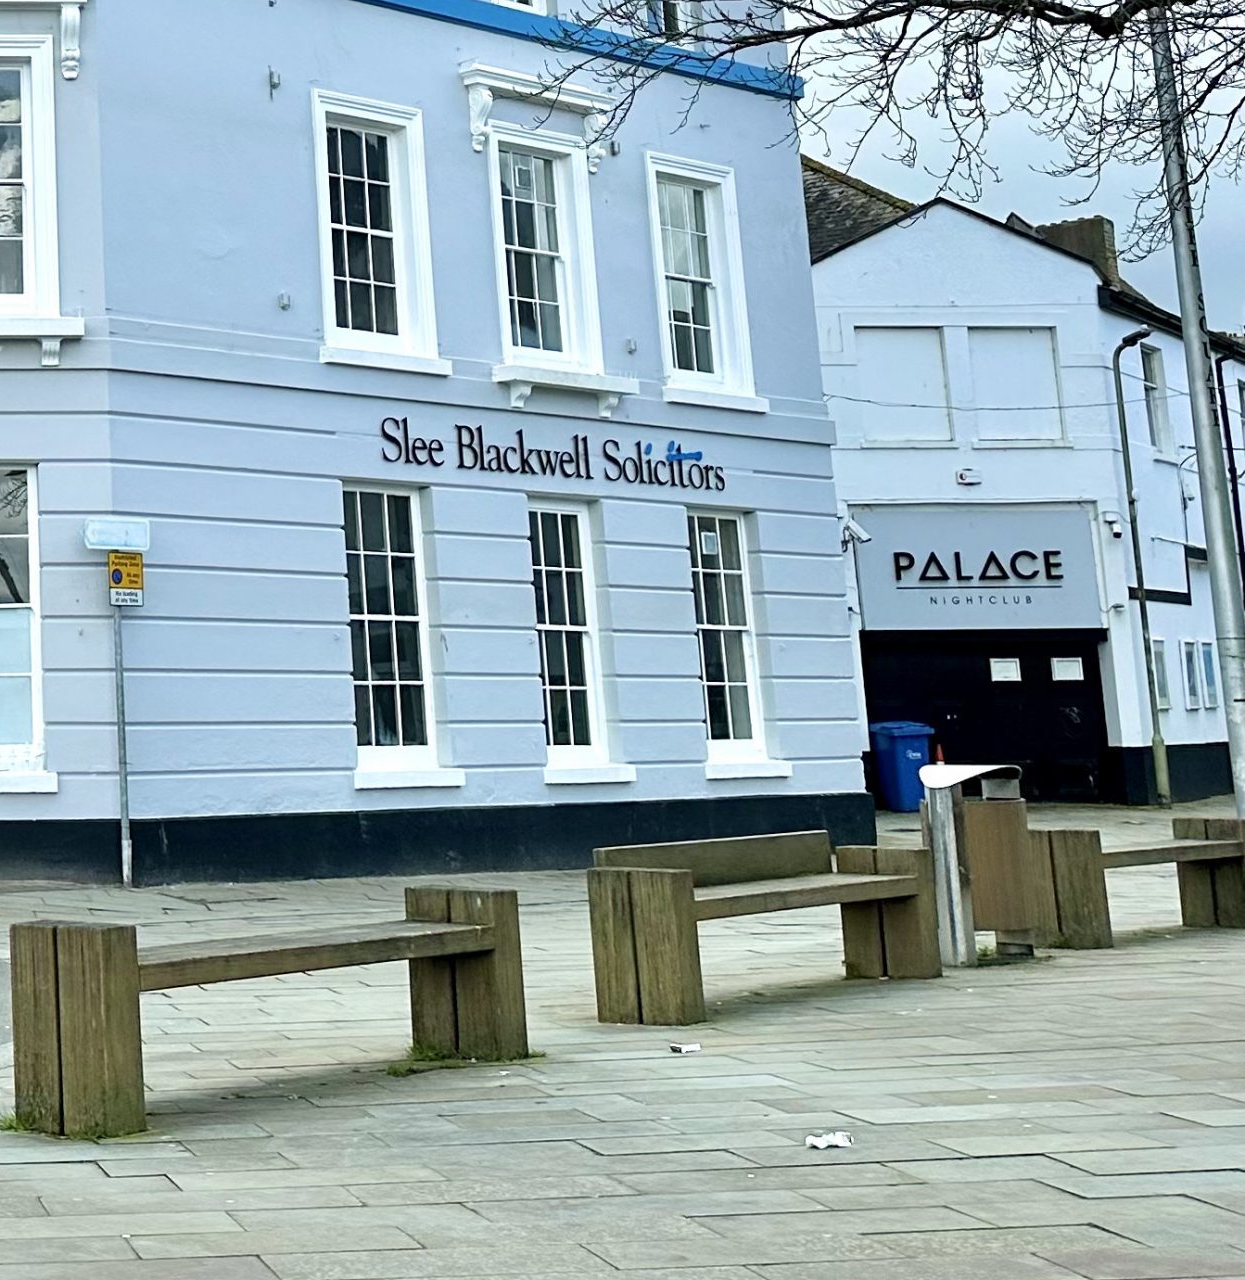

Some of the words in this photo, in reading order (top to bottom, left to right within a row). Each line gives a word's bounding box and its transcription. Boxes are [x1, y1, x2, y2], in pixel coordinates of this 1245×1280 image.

[380, 417, 445, 467] Slee
[455, 423, 594, 480] Blackwell
[603, 439, 726, 491] Solicitors
[893, 550, 1064, 582] PALACE
[929, 595, 1033, 605] NIGHTCLUB
